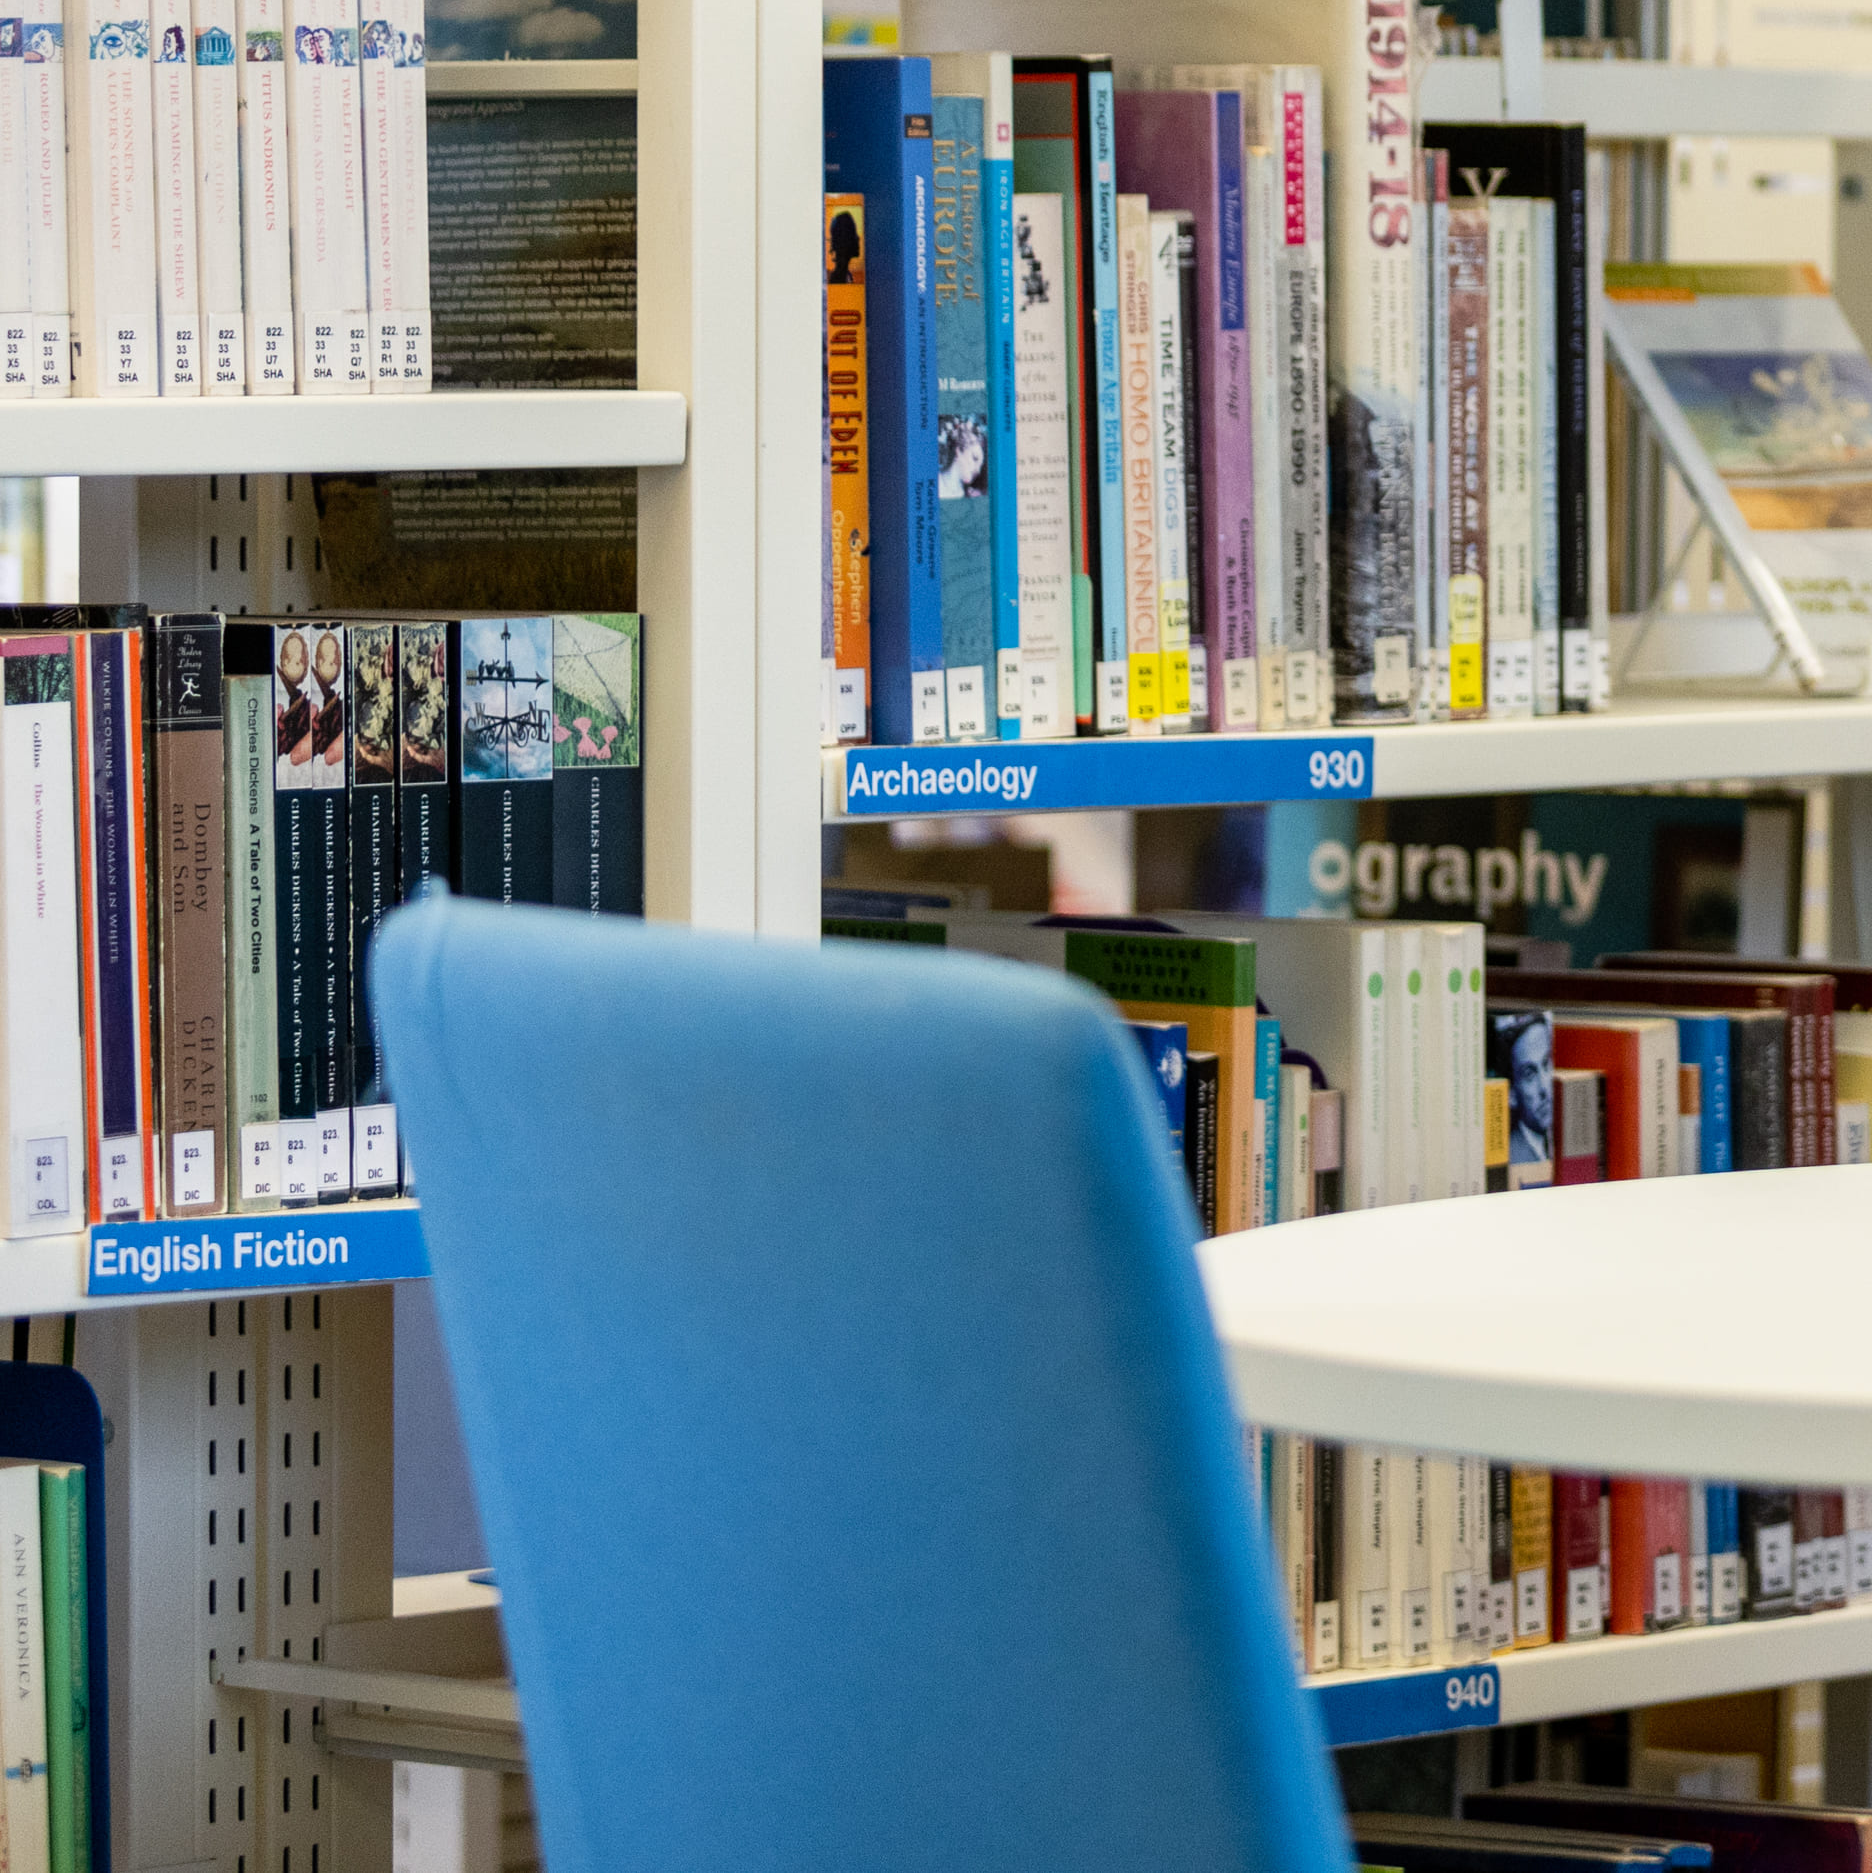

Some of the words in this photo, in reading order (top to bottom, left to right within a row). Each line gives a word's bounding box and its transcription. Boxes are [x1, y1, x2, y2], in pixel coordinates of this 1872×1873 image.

[168, 71, 180, 106] THE
[261, 70, 273, 121] TITUS
[170, 111, 182, 176] TAMING
[172, 179, 183, 202] OF
[263, 125, 276, 232] ANDRONICUS
[173, 204, 184, 240] THE
[932, 138, 958, 308] EUROPE
[959, 167, 979, 268] History
[174, 242, 186, 301] SHREW
[829, 308, 862, 360] OUT
[1160, 318, 1174, 378] TIME
[829, 370, 859, 398] OF
[829, 410, 863, 475] EDEN
[1162, 384, 1176, 458] TEAM
[846, 537, 863, 625] Stephen
[103, 660, 112, 712] WILKIE
[104, 715, 114, 779] COLLINS
[248, 697, 257, 754] Charles
[249, 756, 259, 815] Dickens
[848, 759, 1038, 801] Archaeology
[1308, 749, 1366, 791] 930
[106, 790, 115, 819] THE
[172, 803, 189, 852] and
[250, 823, 261, 836] A
[107, 824, 117, 887] WOMAN
[191, 803, 212, 913] Dombey
[250, 838, 261, 872] Tale
[291, 798, 301, 871] CHARLES
[108, 890, 118, 909] IN
[172, 865, 189, 915] Son
[250, 875, 261, 892] of
[292, 875, 302, 943] DICKENS
[108, 912, 119, 965] WHITE
[250, 893, 262, 933] Two
[251, 934, 262, 975] Cities
[293, 976, 303, 1011] Tale
[293, 1028, 303, 1059] Two
[294, 1062, 303, 1106] Cities
[184, 1190, 201, 1201] DIC
[94, 1233, 222, 1284] English
[233, 1229, 349, 1270] Fiction
[14, 1533, 27, 1579] ANN
[16, 1587, 31, 1702] VERONICA
[1446, 1672, 1495, 1711] 940
